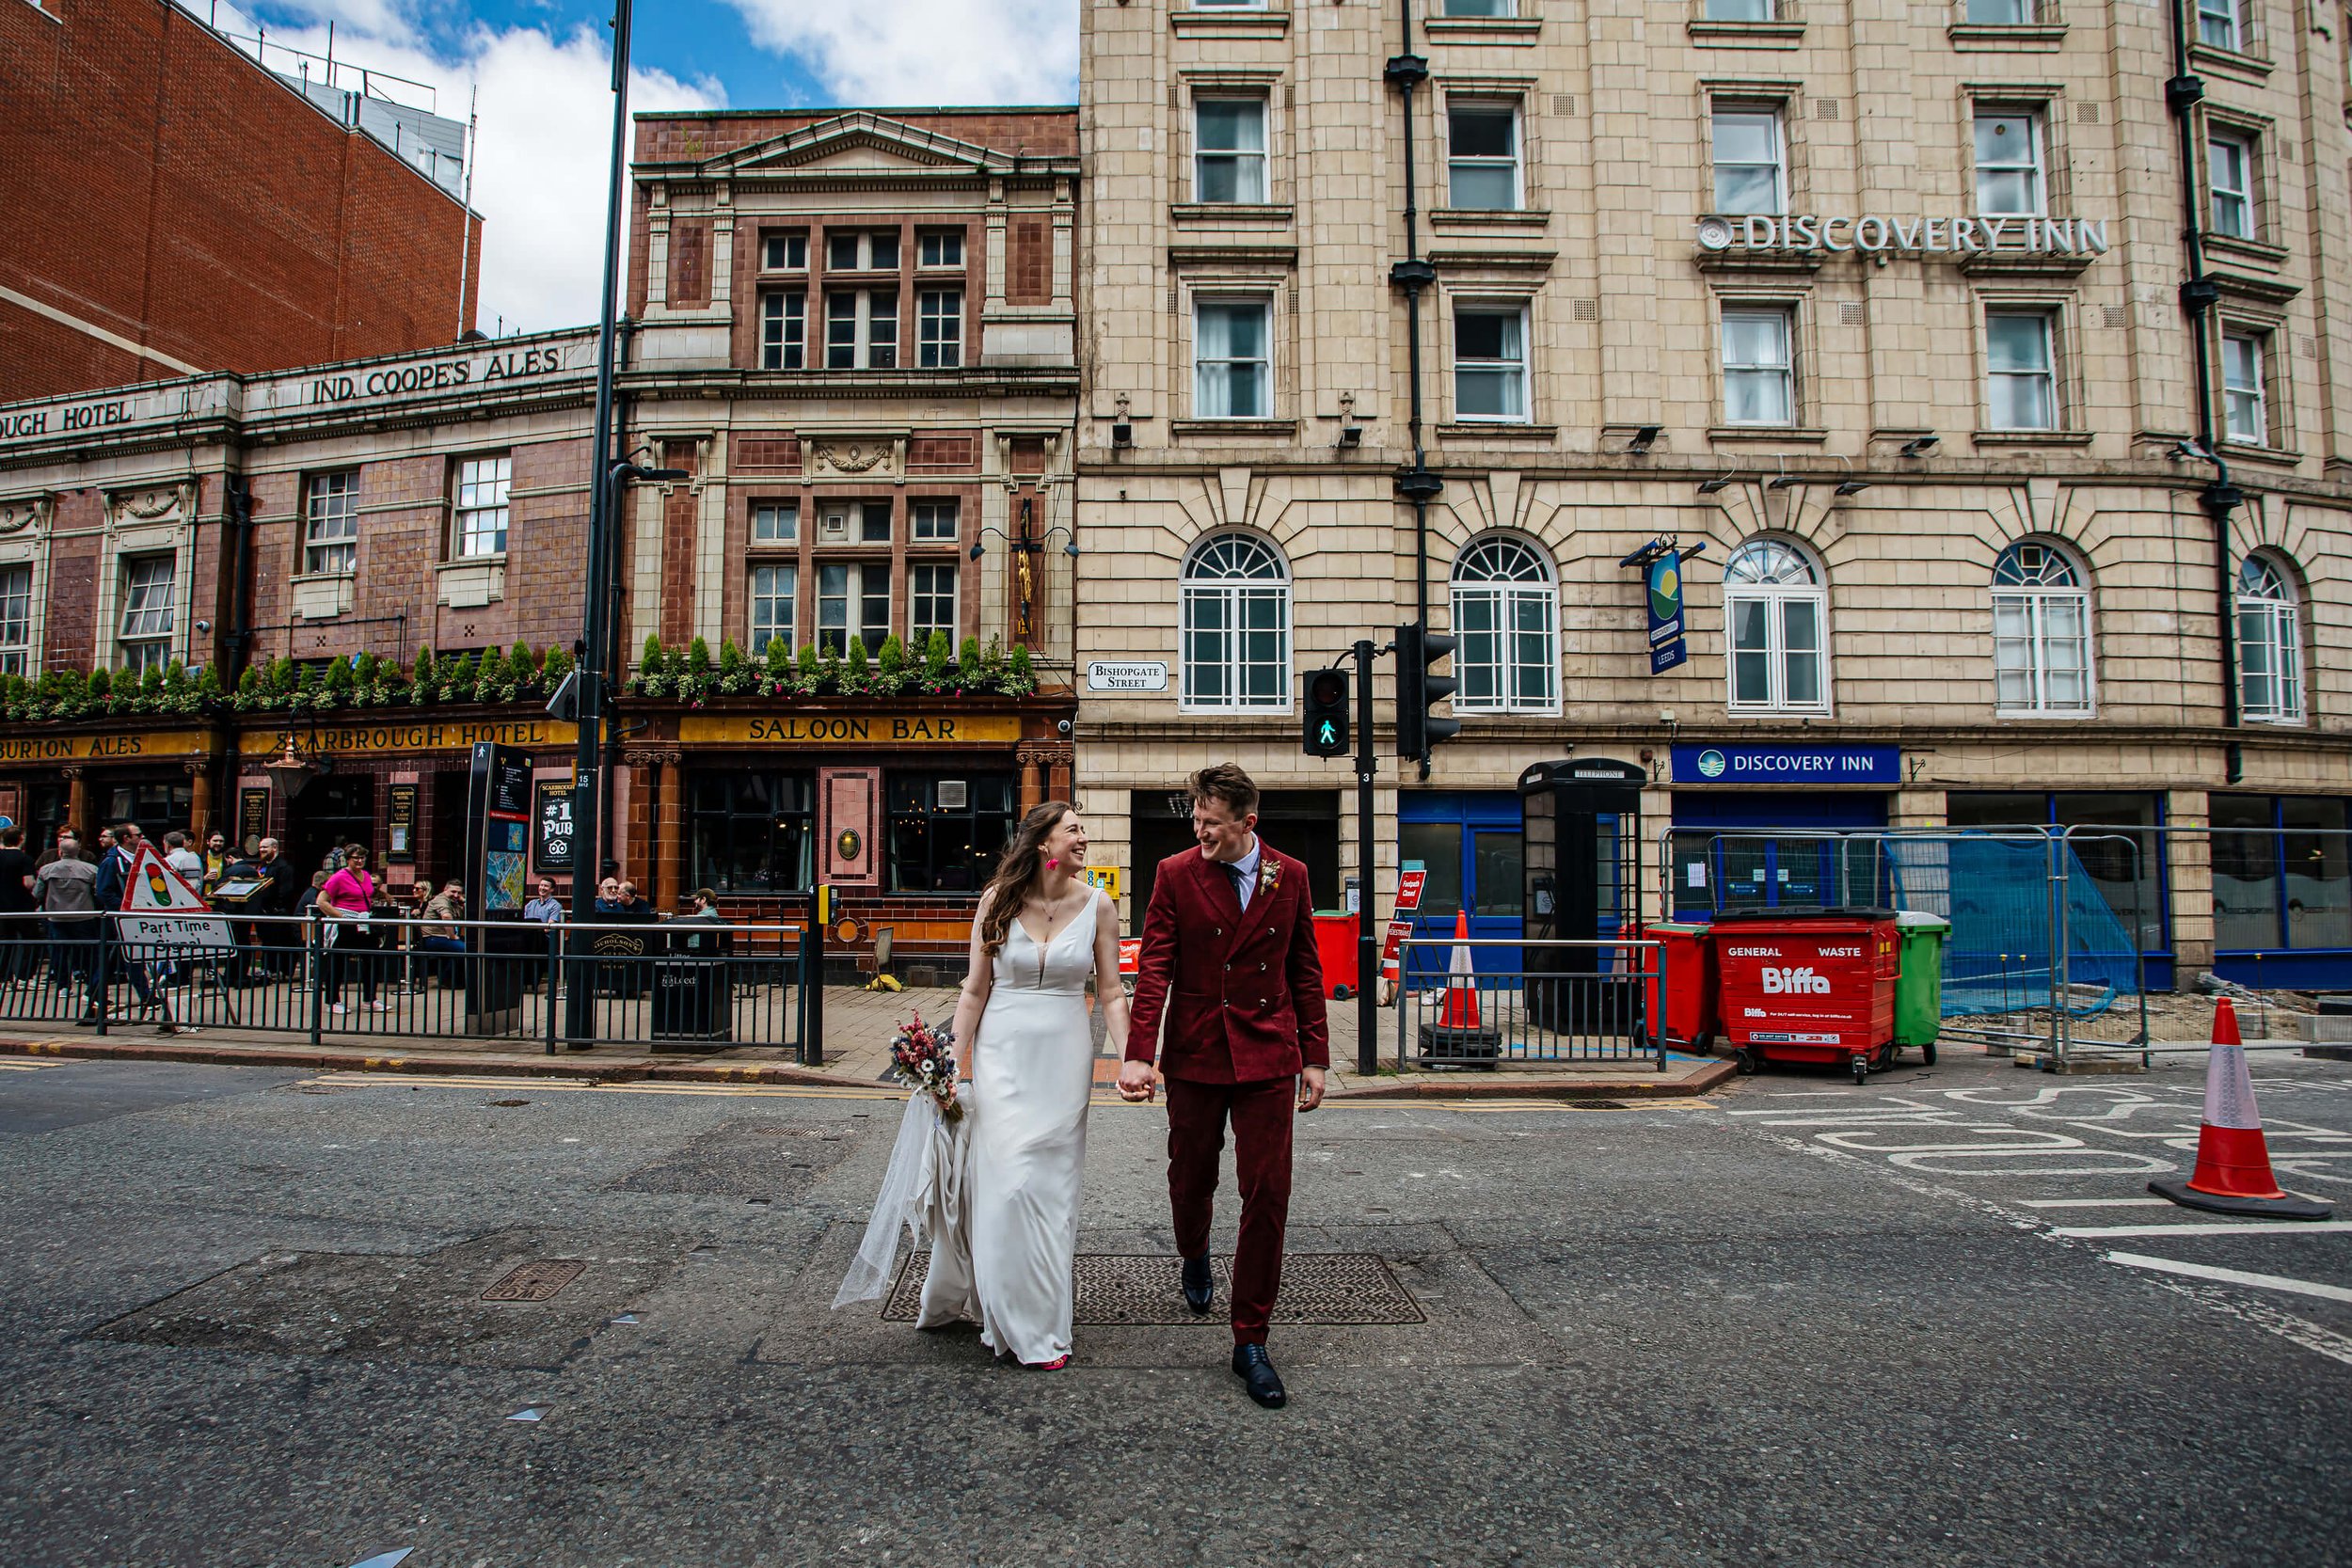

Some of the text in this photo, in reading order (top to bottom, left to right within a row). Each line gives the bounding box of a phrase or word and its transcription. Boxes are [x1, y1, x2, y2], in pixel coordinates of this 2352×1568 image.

[1743, 215, 2107, 256] DISCOVERY INN
[312, 347, 561, 404] IND. COOPE'S ALES
[63, 401, 133, 431] HOTEL
[1658, 650, 1676, 665] LEEDS
[1095, 665, 1160, 676] BISHOPGATE
[1107, 676, 1147, 688] STREET
[277, 721, 544, 752] SCARBROUGH HOTEL
[750, 719, 956, 739] SALOON BAR
[88, 736, 142, 756] ALES
[1734, 755, 1874, 771] DISCOVERY INN
[1363, 773, 1370, 782] 3
[545, 802, 572, 820] #1
[808, 885, 815, 895] 4
[139, 920, 211, 934] Part Time
[1728, 947, 1862, 958] GENERAL WASTE
[1761, 967, 1831, 994] Biffa
[1744, 1008, 1767, 1018] Biffa
